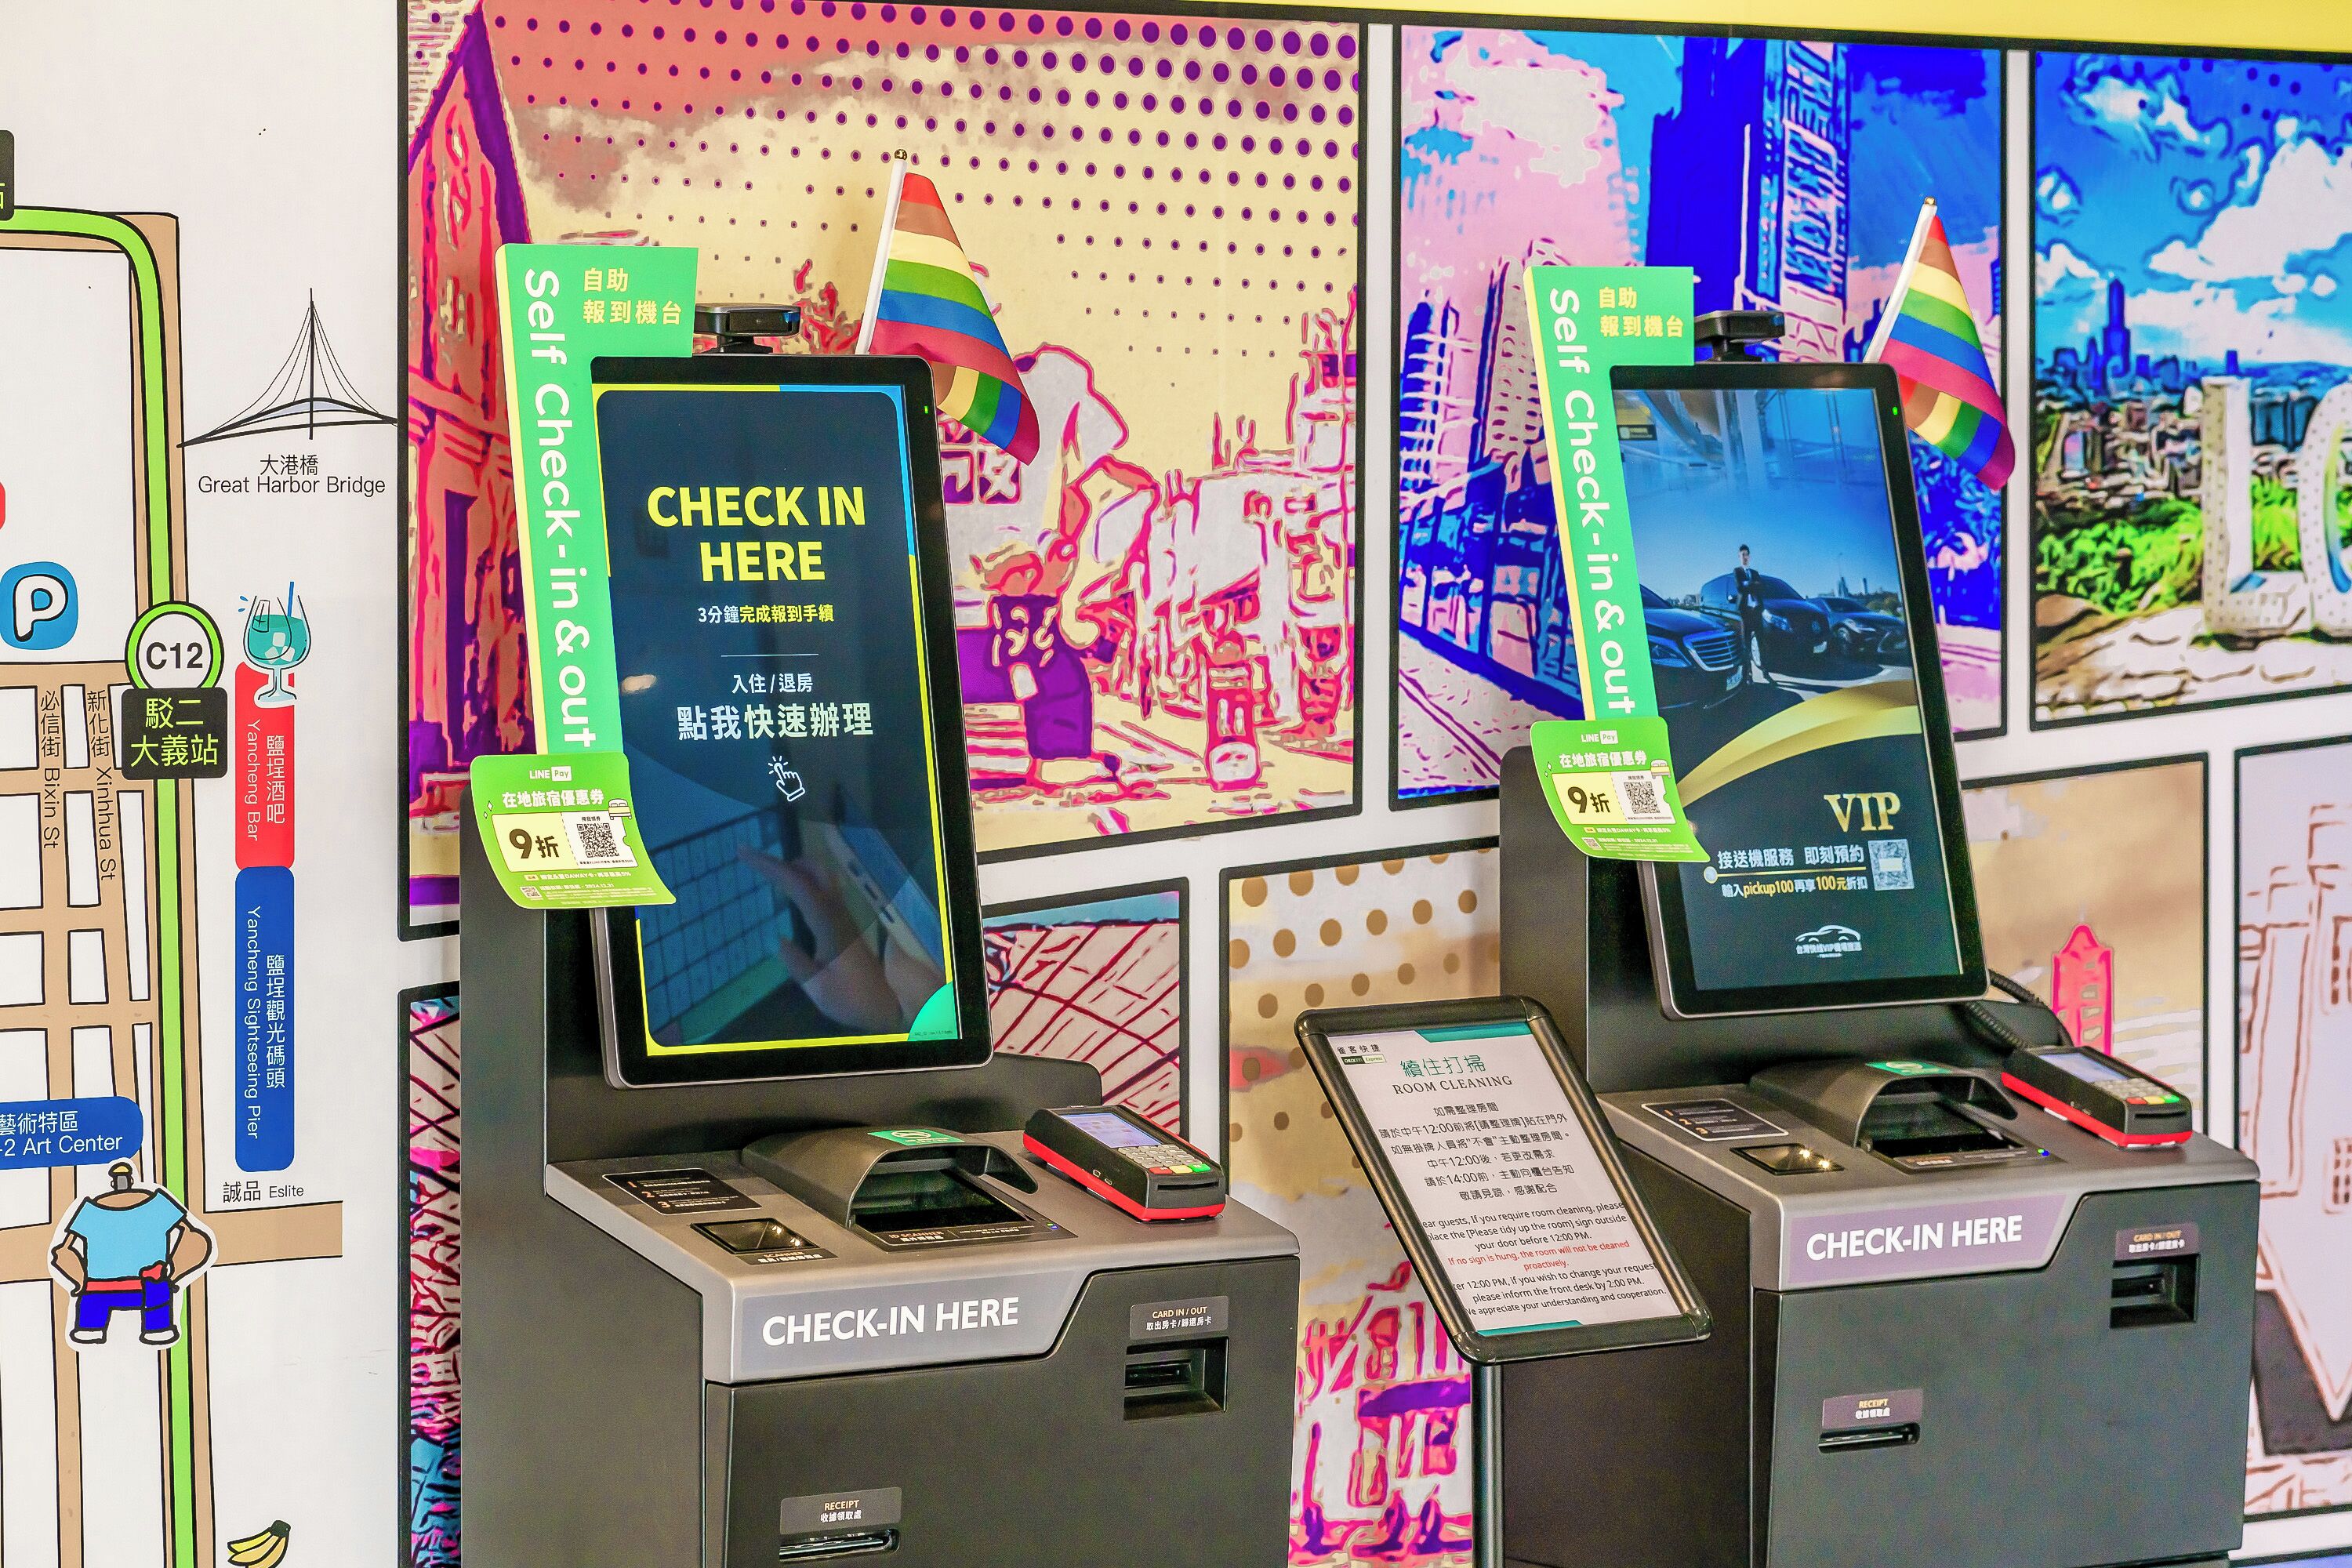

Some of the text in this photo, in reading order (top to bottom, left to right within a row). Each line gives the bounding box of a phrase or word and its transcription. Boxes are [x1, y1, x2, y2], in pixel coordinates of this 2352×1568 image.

[583, 267, 628, 292] 自助
[1599, 286, 1637, 309] 自助
[583, 299, 681, 325] 報到機台
[1600, 314, 1683, 337] 報到機台
[260, 454, 318, 476] 大港橋
[198, 476, 387, 496] Great Harbor Bridge
[524, 268, 597, 747] Self Check-in & out
[647, 486, 866, 527] CHECK IN
[1550, 288, 1635, 713] Self Check-in & out
[700, 541, 826, 583] HERE
[13, 574, 69, 641] P
[698, 604, 834, 624] 3分鐘完成報到手續
[146, 642, 203, 669] C12
[731, 673, 767, 694] 入住
[779, 673, 814, 693] 退房
[40, 690, 61, 757] 必信街
[87, 690, 110, 757] 新化街
[145, 698, 204, 729] 駁二
[677, 702, 873, 741] 點我快速辦理
[1581, 734, 1600, 742] LINE
[130, 735, 219, 768] 大義站
[1559, 750, 1647, 768] 在地旅宿優惠券
[245, 719, 261, 841] Yancheng Bar
[267, 735, 285, 824] 鹽埕酒吧
[529, 769, 569, 779] LINE Pay
[44, 768, 60, 849] Bixin St
[502, 789, 604, 808] 在地旅宿優惠券
[1824, 791, 1901, 833] VIP
[100, 858, 116, 880] St
[1717, 848, 1795, 869] 接送機服務
[1804, 844, 1864, 865] 即刻預約
[245, 906, 261, 1139] Yancheng Sightseeing Pier
[267, 954, 285, 1089] 鹽埕觀光碼頭
[1400, 1054, 1486, 1077] 續住打掃
[1392, 1075, 1513, 1094] ROOM CLEANING
[1433, 1102, 1499, 1116] 如需整理房間
[0, 1110, 78, 1135] 藝術特區
[23, 1137, 52, 1156] Art
[59, 1134, 123, 1153] Center
[223, 1181, 261, 1203] 誠品
[269, 1185, 304, 1198] Eslite
[1439, 1218, 1470, 1229] guests,
[1479, 1214, 1497, 1225] you
[1498, 1211, 1530, 1222] require
[1532, 1208, 1555, 1217] room
[1556, 1205, 1595, 1215] cleaning,
[1596, 1202, 1624, 1213] please
[1450, 1230, 1465, 1239] the
[1499, 1224, 1516, 1236] tidy
[1518, 1224, 1530, 1233] up
[1531, 1221, 1546, 1231] the
[1576, 1218, 1593, 1229] sign
[1595, 1214, 1627, 1224] outside
[1475, 1231, 1592, 1252] your door before 12:00 PM.
[1806, 1214, 2023, 1261] CHECK-IN HERE
[1469, 1255, 1486, 1265] sign
[1497, 1252, 1519, 1263] hung,
[1558, 1246, 1572, 1254] will
[1599, 1240, 1630, 1250] cleaned
[1523, 1258, 1569, 1272] proactively.
[1467, 1279, 1490, 1290] 12:00
[1492, 1277, 1510, 1287] PM,
[1512, 1276, 1519, 1285] if
[1519, 1276, 1536, 1286] you
[1537, 1272, 1557, 1281] wish
[1570, 1269, 1601, 1279] change
[1603, 1266, 1622, 1276] your
[1472, 1276, 1645, 1304] please inform the front desk by 2:00 PM.
[1152, 1309, 1174, 1319] CARD
[1176, 1308, 1185, 1316] IN
[1190, 1306, 1207, 1315] OUT
[1478, 1305, 1520, 1316] appreciate
[1521, 1301, 1539, 1312] your
[1541, 1295, 1599, 1308] understanding
[1601, 1293, 1615, 1301] and
[1617, 1288, 1667, 1300] cooperation.
[762, 1296, 1019, 1347] CHECK-IN HERE
[1859, 1399, 1889, 1409] RECEIPT
[824, 1499, 860, 1511] RECEIPT
